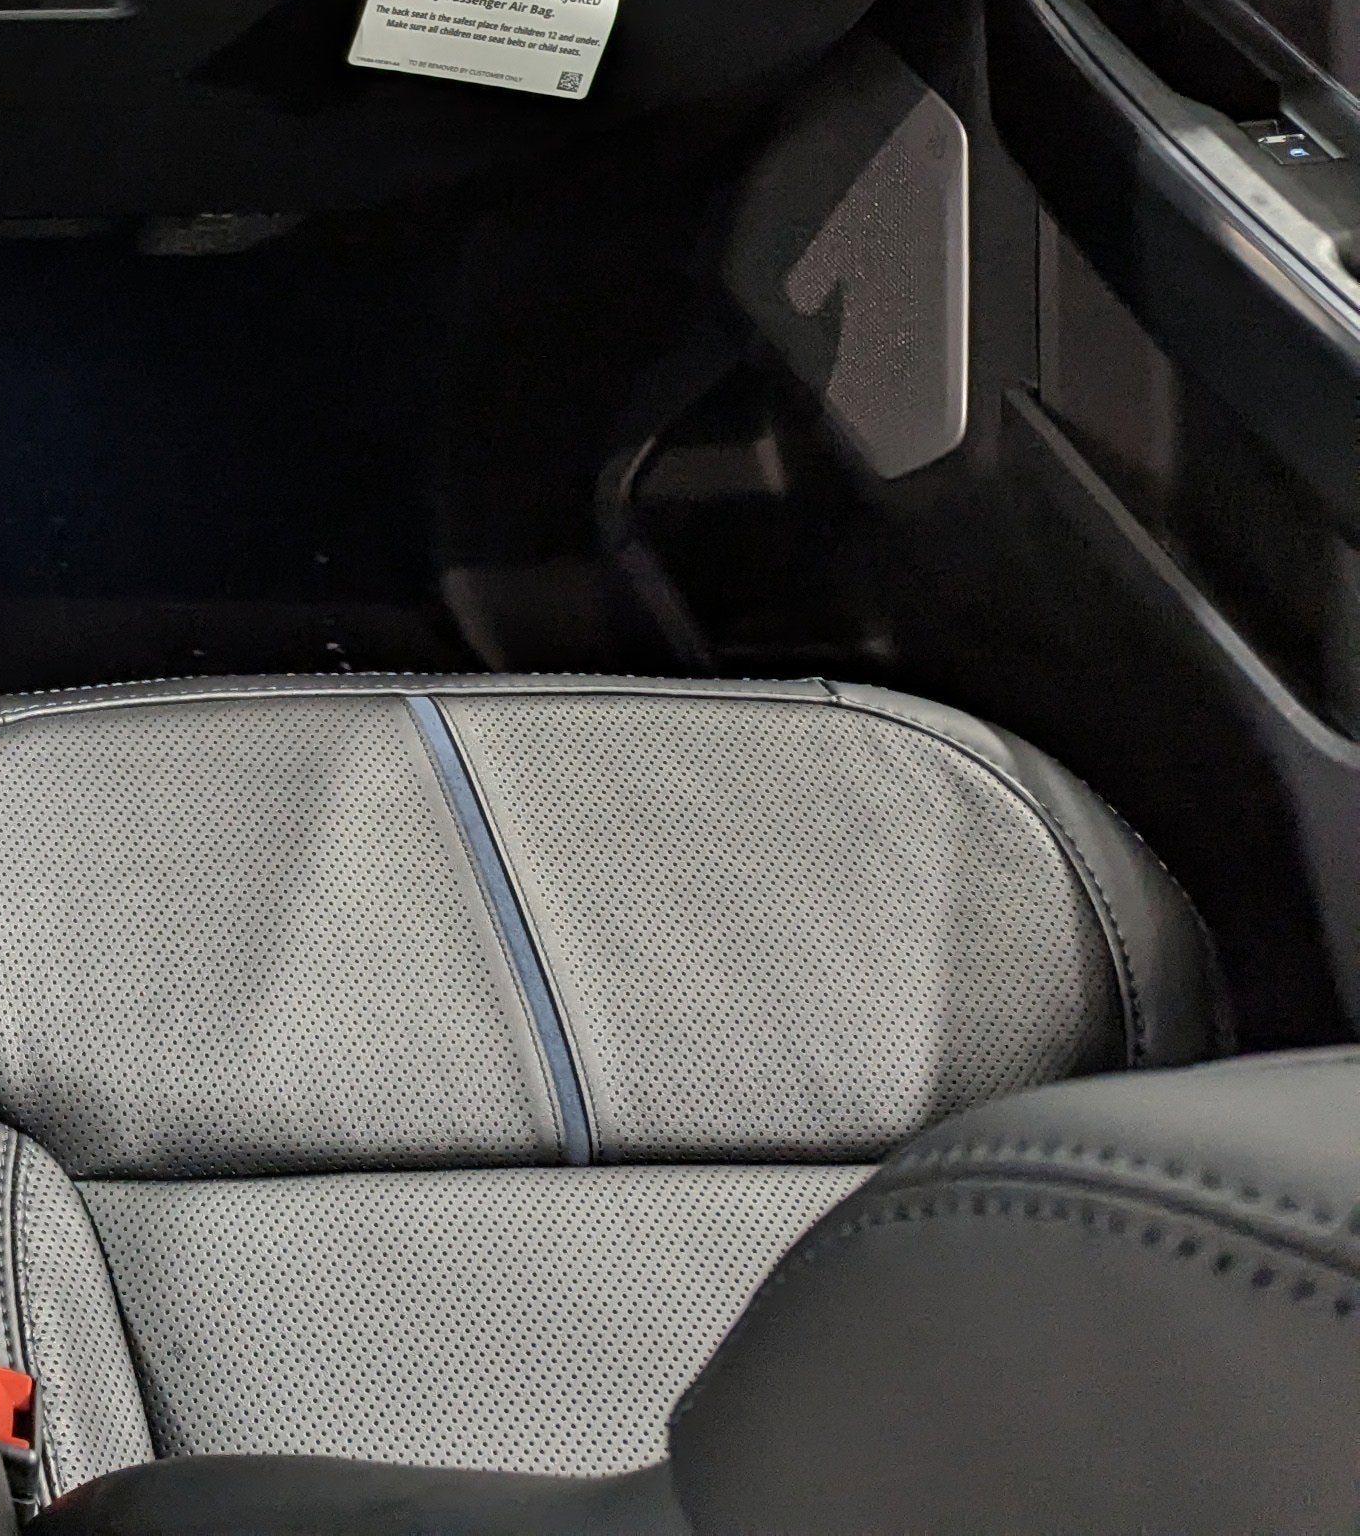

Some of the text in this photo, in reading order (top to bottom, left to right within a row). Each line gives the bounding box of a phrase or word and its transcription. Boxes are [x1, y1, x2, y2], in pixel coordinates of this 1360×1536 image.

[376, 4, 601, 47] The back seat is the safest place for children 12 and under.
[509, 1, 528, 13] Air
[530, 4, 555, 19] Bag.
[386, 18, 581, 56] Make sure all children use seat belts or child seats.
